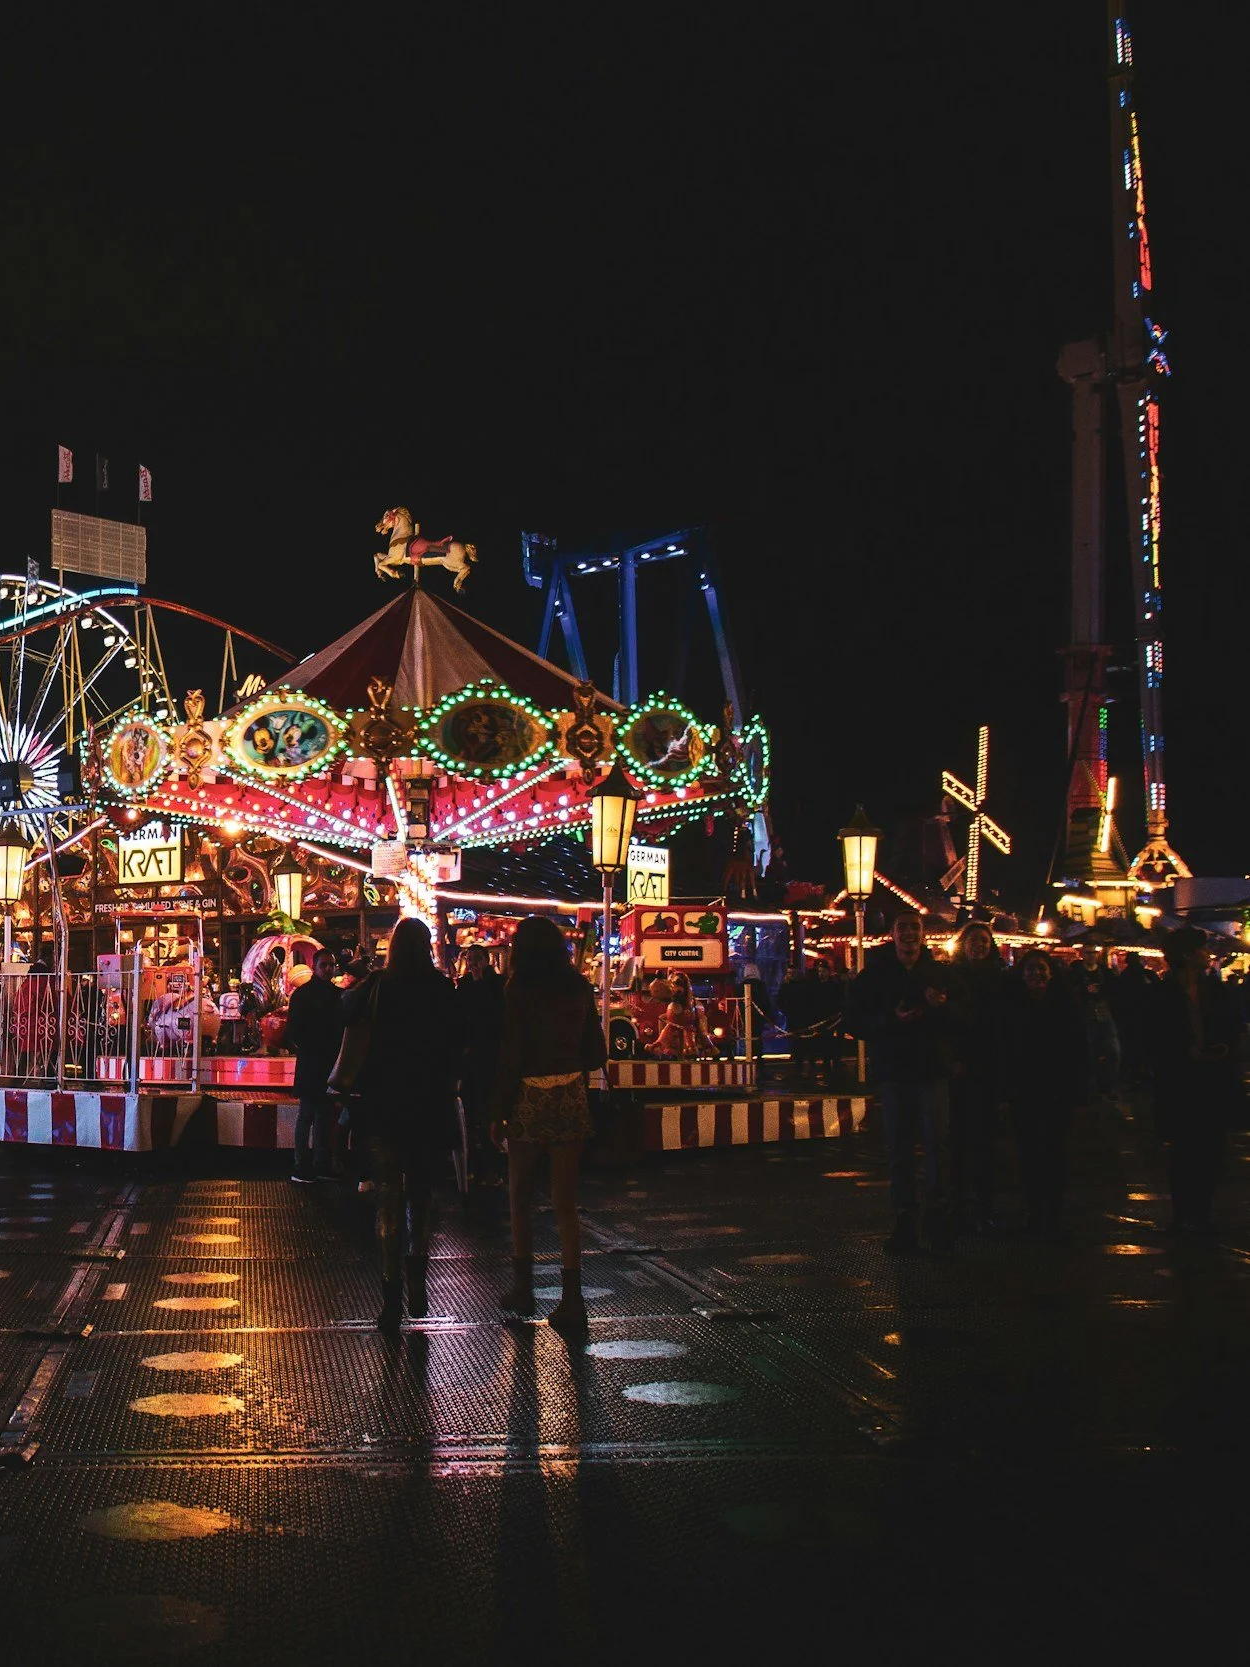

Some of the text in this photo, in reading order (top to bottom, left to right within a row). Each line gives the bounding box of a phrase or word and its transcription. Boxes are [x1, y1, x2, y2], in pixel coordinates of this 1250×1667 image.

[122, 847, 177, 878] KRAFT
[629, 850, 666, 865] GERMAN
[630, 870, 666, 901] KRAFT
[202, 899, 217, 907] GIN
